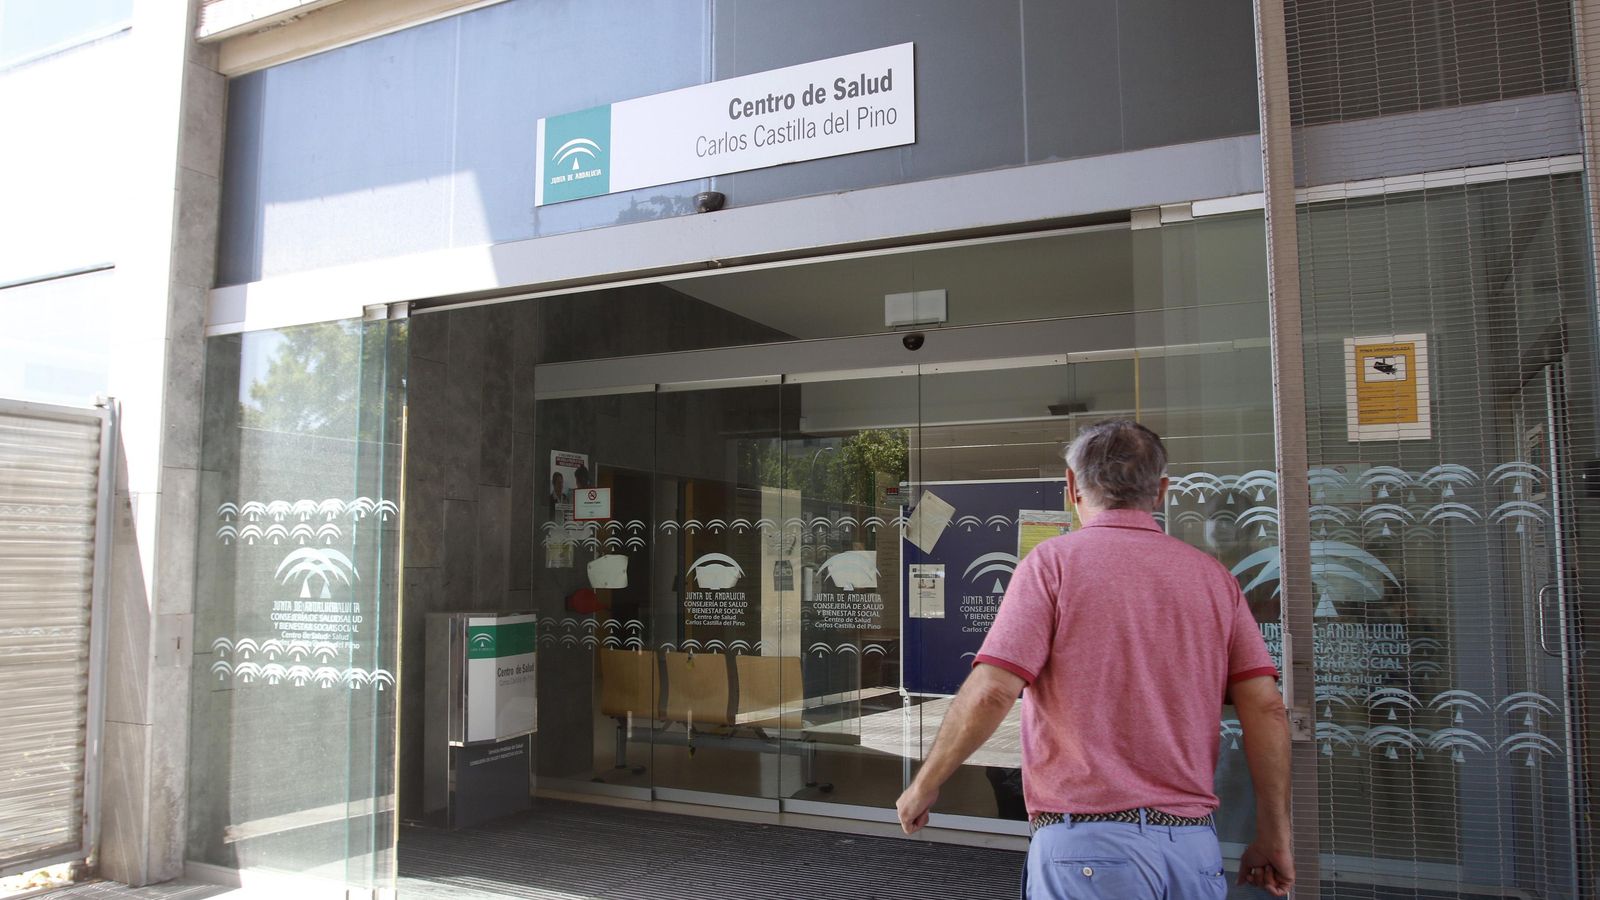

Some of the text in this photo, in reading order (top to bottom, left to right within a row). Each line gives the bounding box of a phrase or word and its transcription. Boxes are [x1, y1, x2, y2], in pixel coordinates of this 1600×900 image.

[728, 68, 893, 121] Centro de Salud
[696, 105, 897, 158] Carlos Castilla del Pino
[685, 591, 746, 601] JUNTA DE ANDALUCIA
[815, 593, 835, 602] JUNTA
[836, 593, 845, 602] DE
[962, 595, 983, 605] JUNTA
[985, 595, 995, 605] DE
[683, 600, 718, 608] CONSEJERÍA
[813, 602, 851, 610] CONSEJERÍA
[822, 609, 857, 617] BIENESTAR
[857, 610, 880, 618] SOCIAL
[1326, 623, 1405, 640] ANDALUCIA
[1362, 642, 1411, 656] SALUD
[497, 662, 535, 678] Centro de Salud
[1351, 657, 1404, 670] SOCIAL
[1344, 672, 1383, 685] Salud
